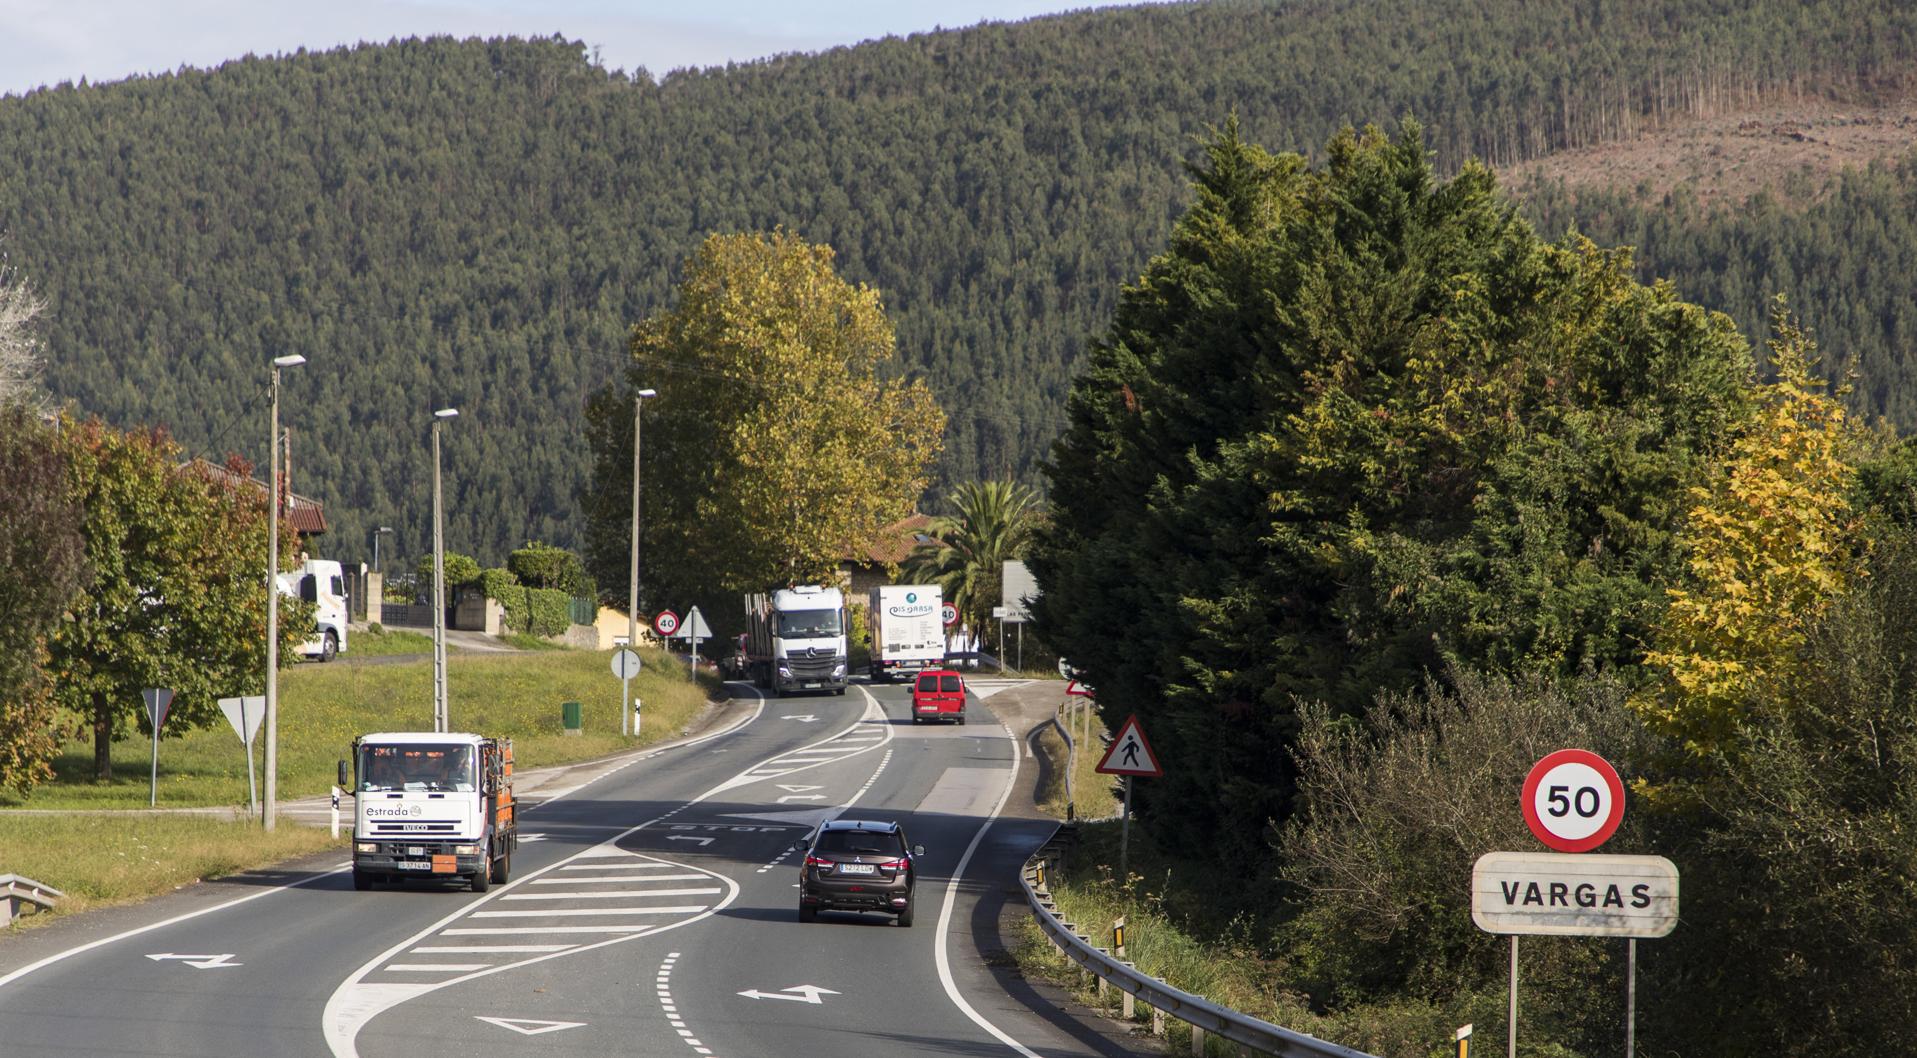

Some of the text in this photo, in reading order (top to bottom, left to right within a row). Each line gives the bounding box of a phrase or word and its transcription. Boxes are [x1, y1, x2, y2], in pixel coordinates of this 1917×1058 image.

[660, 619, 674, 628] 40
[366, 806, 409, 816] estrada
[1547, 785, 1601, 818] 50
[1500, 881, 1651, 909] VARGAS
